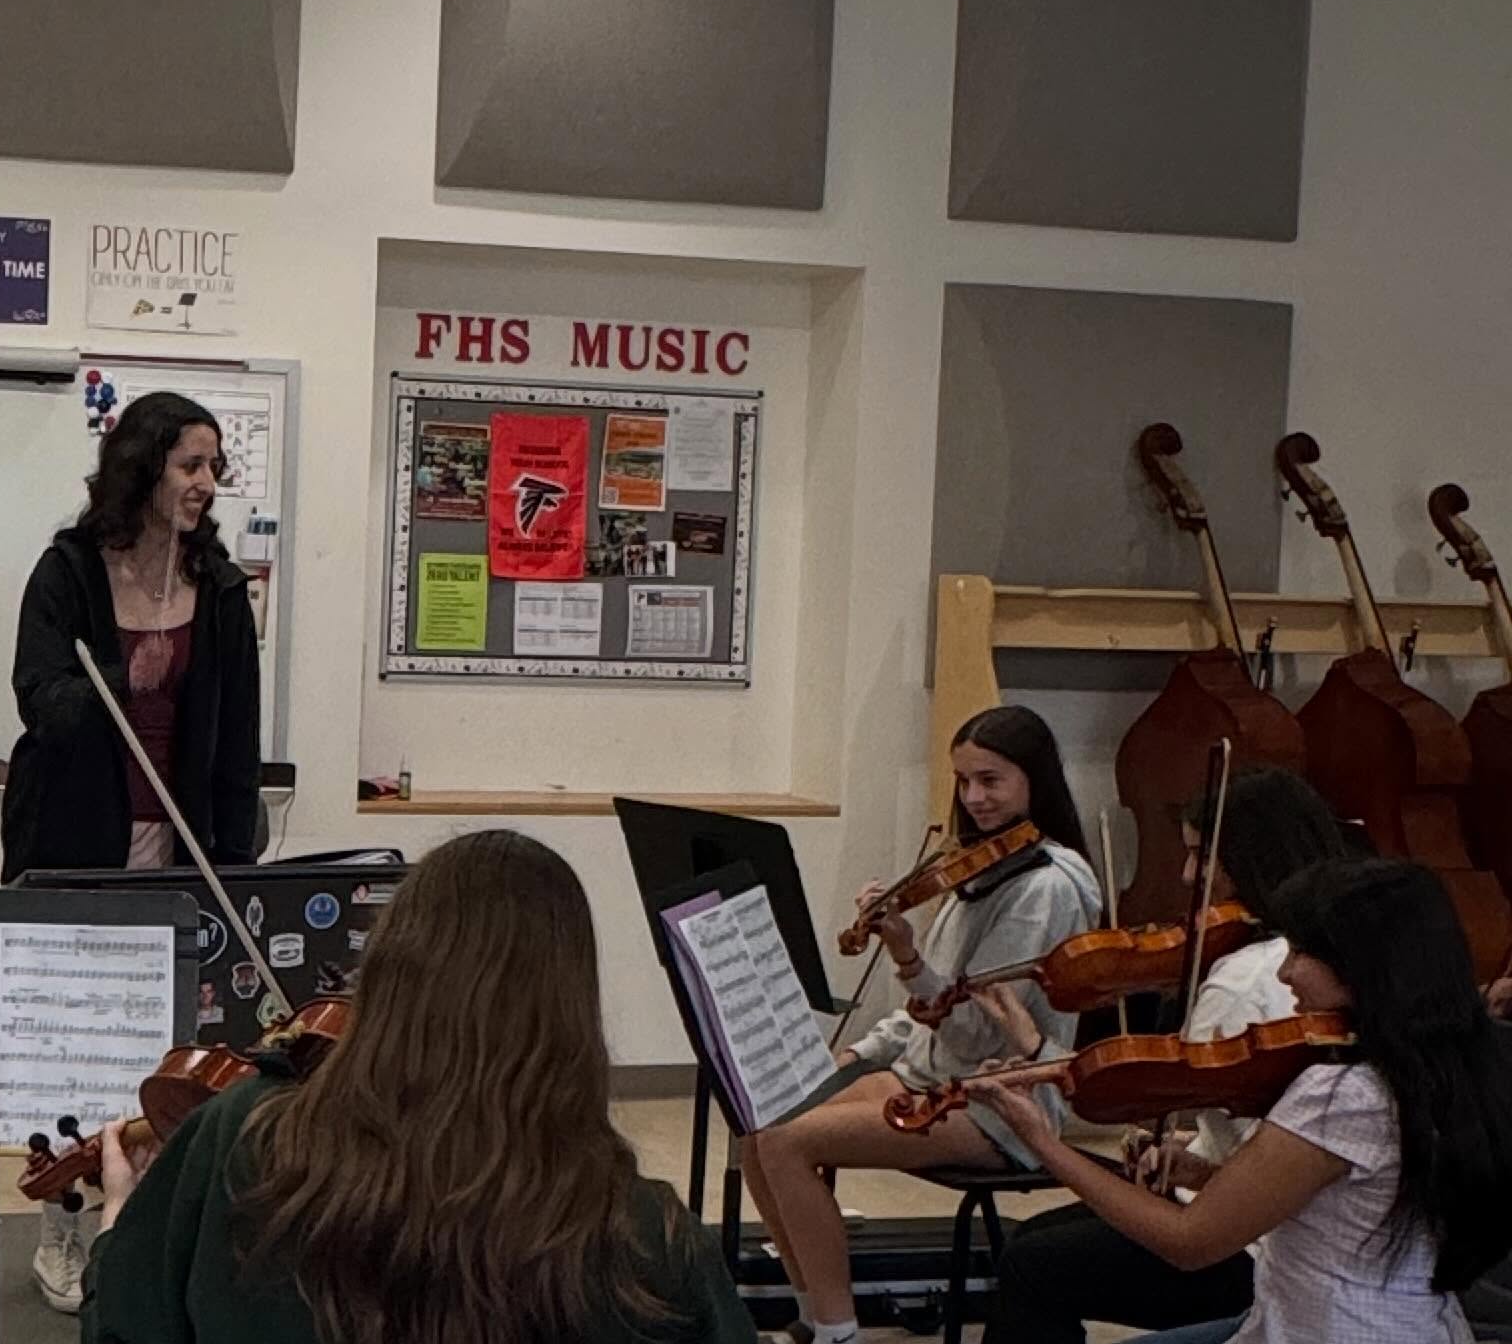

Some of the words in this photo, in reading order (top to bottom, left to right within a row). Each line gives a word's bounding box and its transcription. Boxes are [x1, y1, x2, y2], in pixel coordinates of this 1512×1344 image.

[4, 259, 46, 280] TIME
[92, 225, 240, 277] PRACTICE
[415, 312, 530, 364] FHS
[571, 321, 750, 376] MUSIC
